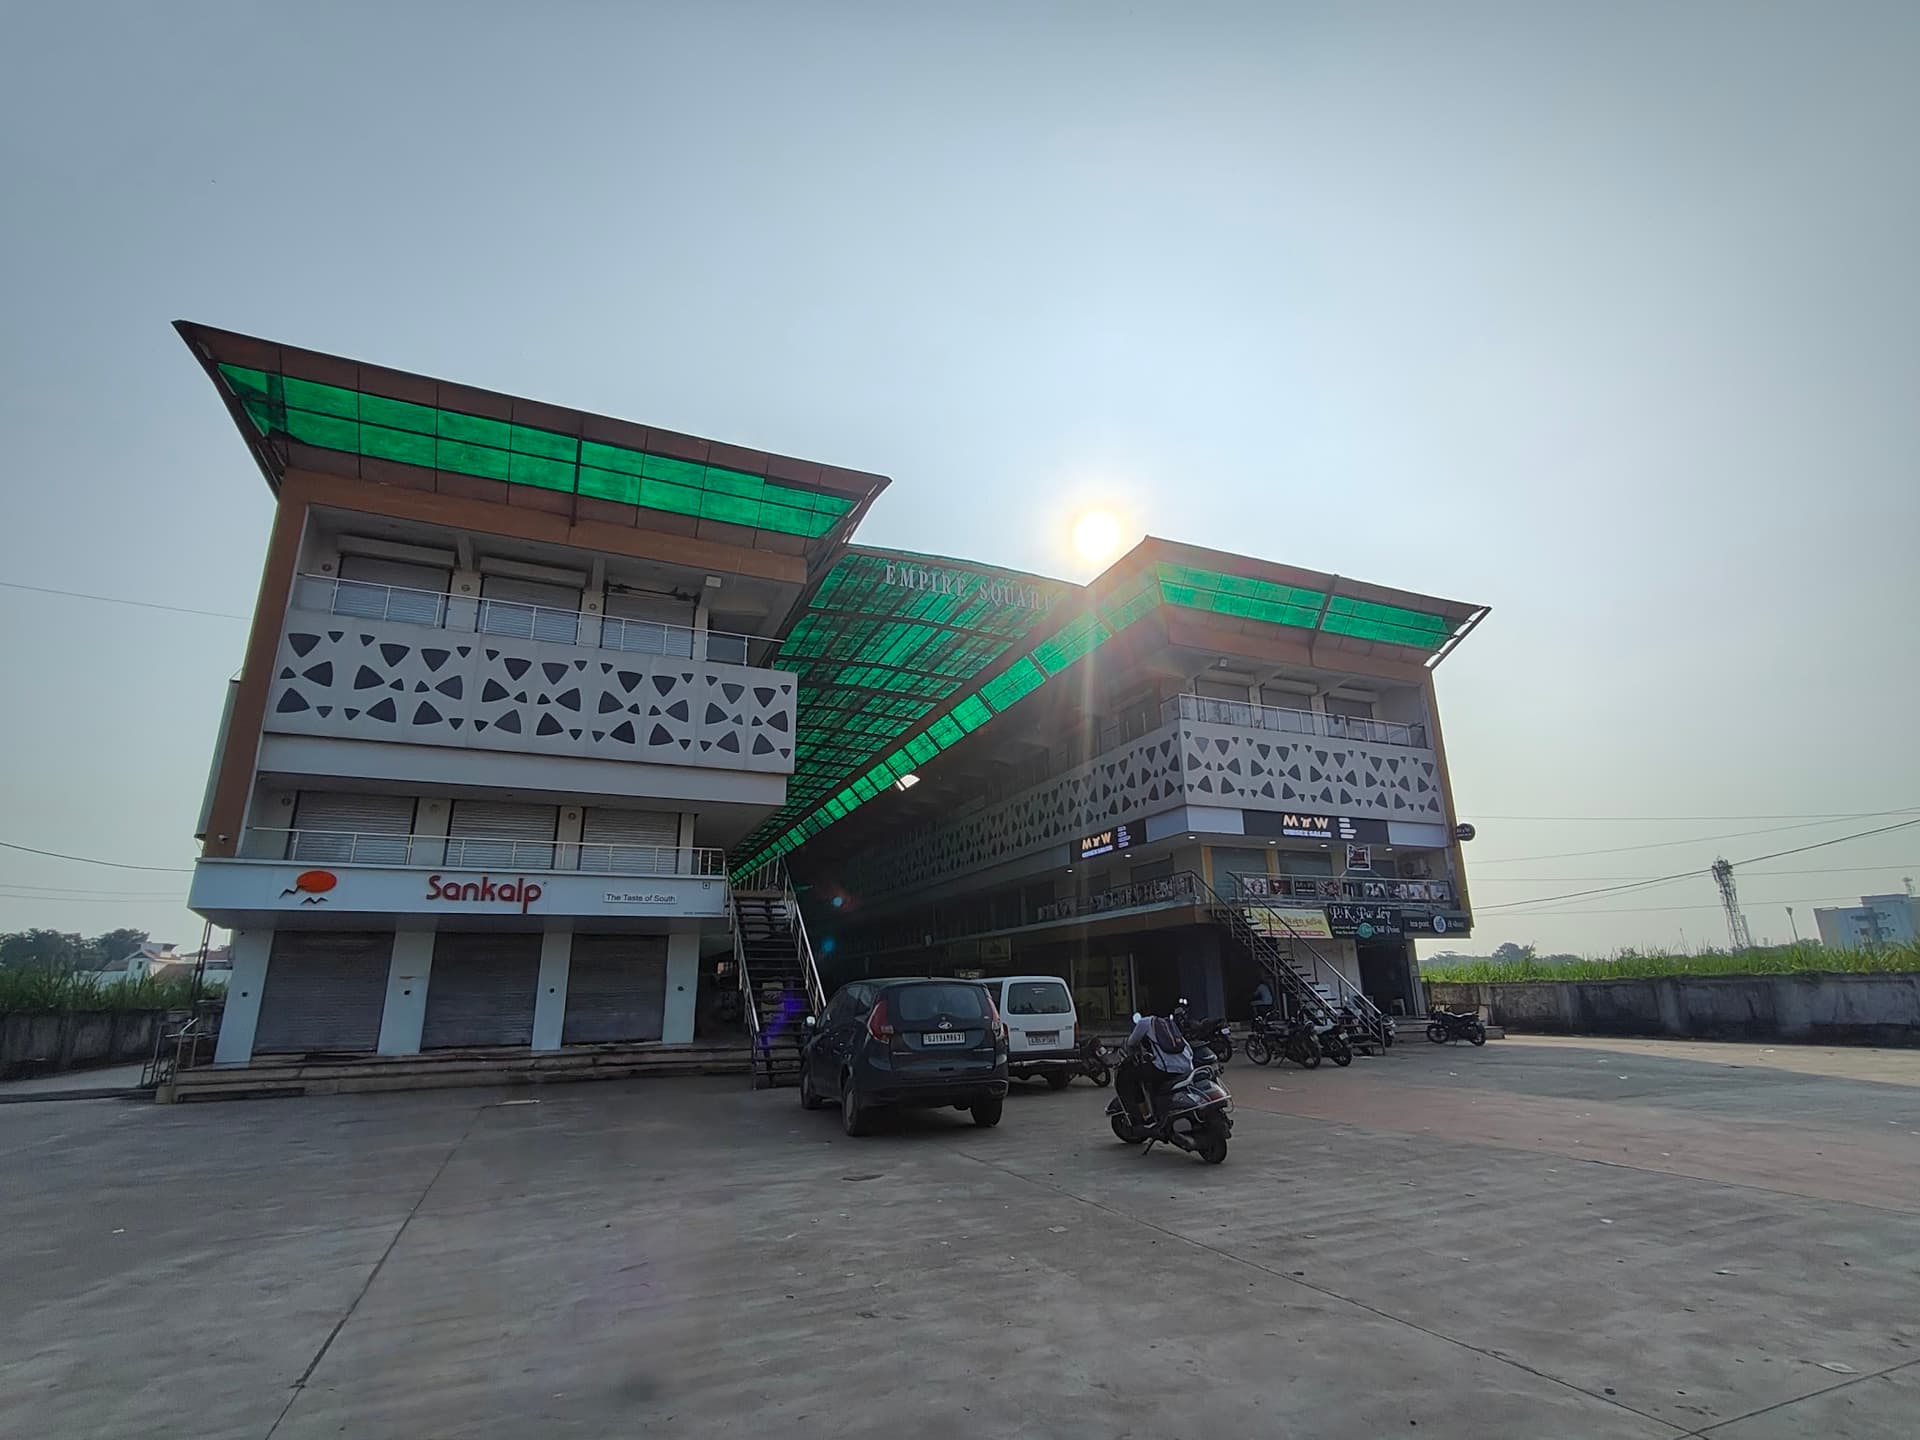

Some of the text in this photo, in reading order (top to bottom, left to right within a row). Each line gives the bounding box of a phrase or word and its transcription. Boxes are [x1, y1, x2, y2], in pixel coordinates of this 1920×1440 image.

[885, 563, 967, 597] EMPIRE
[425, 874, 542, 914] Sankalp
[607, 893, 676, 903] The Taste of South
